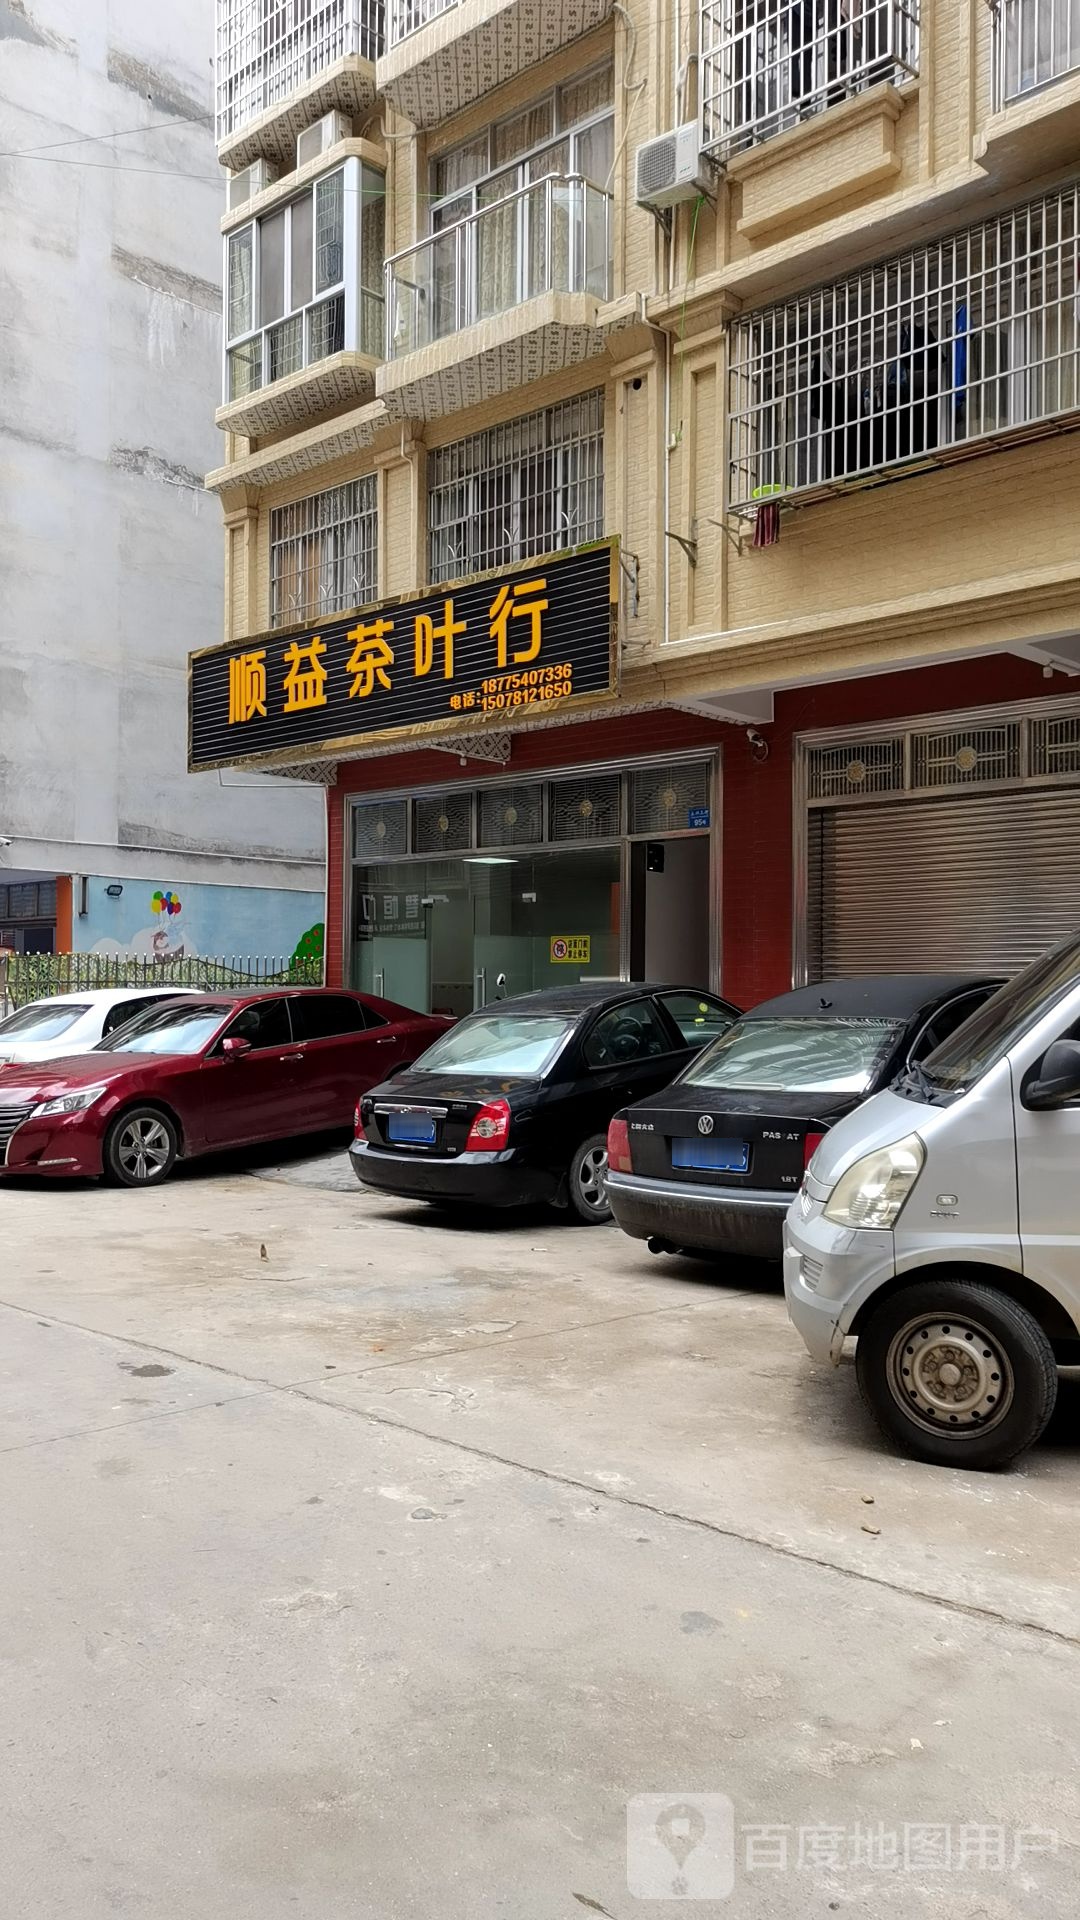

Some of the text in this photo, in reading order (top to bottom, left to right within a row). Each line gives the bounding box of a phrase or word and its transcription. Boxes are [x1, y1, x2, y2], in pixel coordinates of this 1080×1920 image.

[229, 578, 549, 725] 顺益茶叶行
[481, 663, 573, 694] 18775407336
[481, 681, 572, 711] 15078121650
